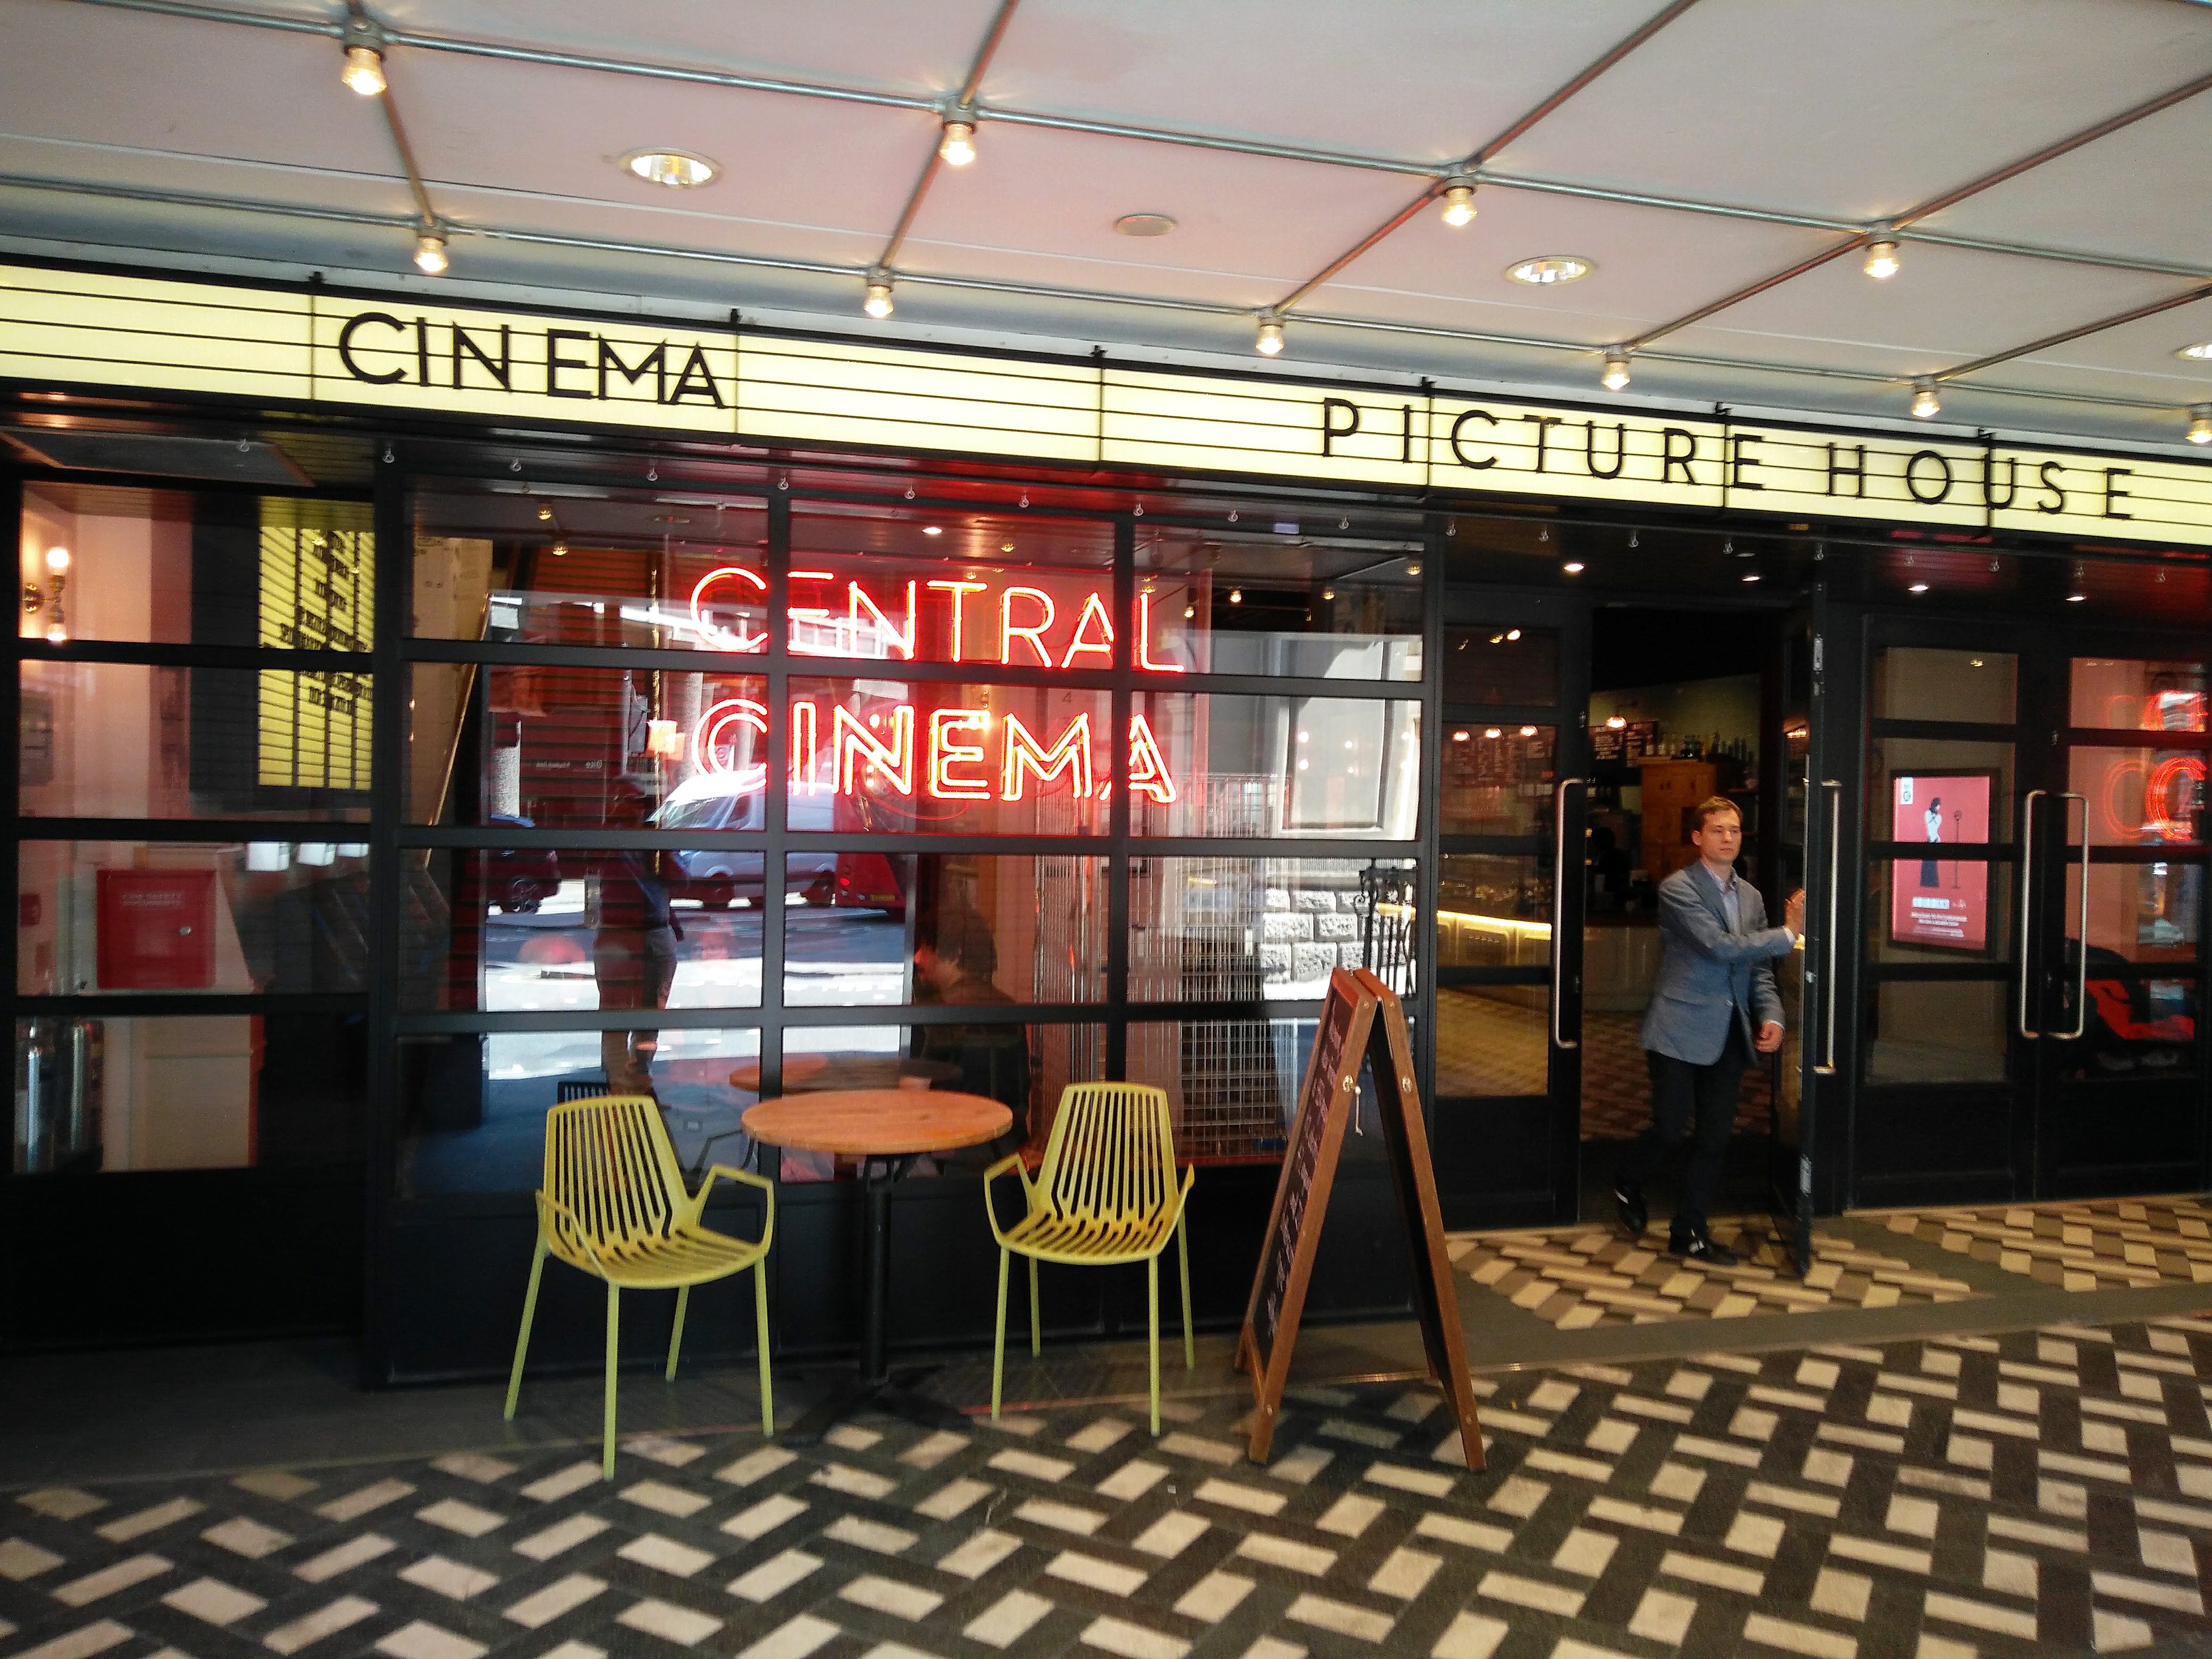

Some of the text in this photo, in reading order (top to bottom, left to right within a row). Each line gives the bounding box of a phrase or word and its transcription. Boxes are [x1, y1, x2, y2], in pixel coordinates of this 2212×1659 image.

[339, 312, 726, 409] CINEMA
[1322, 398, 2134, 520] PICTURE HOUSE
[690, 567, 1185, 672] CENTRAL
[691, 698, 1178, 803] CINEMA
